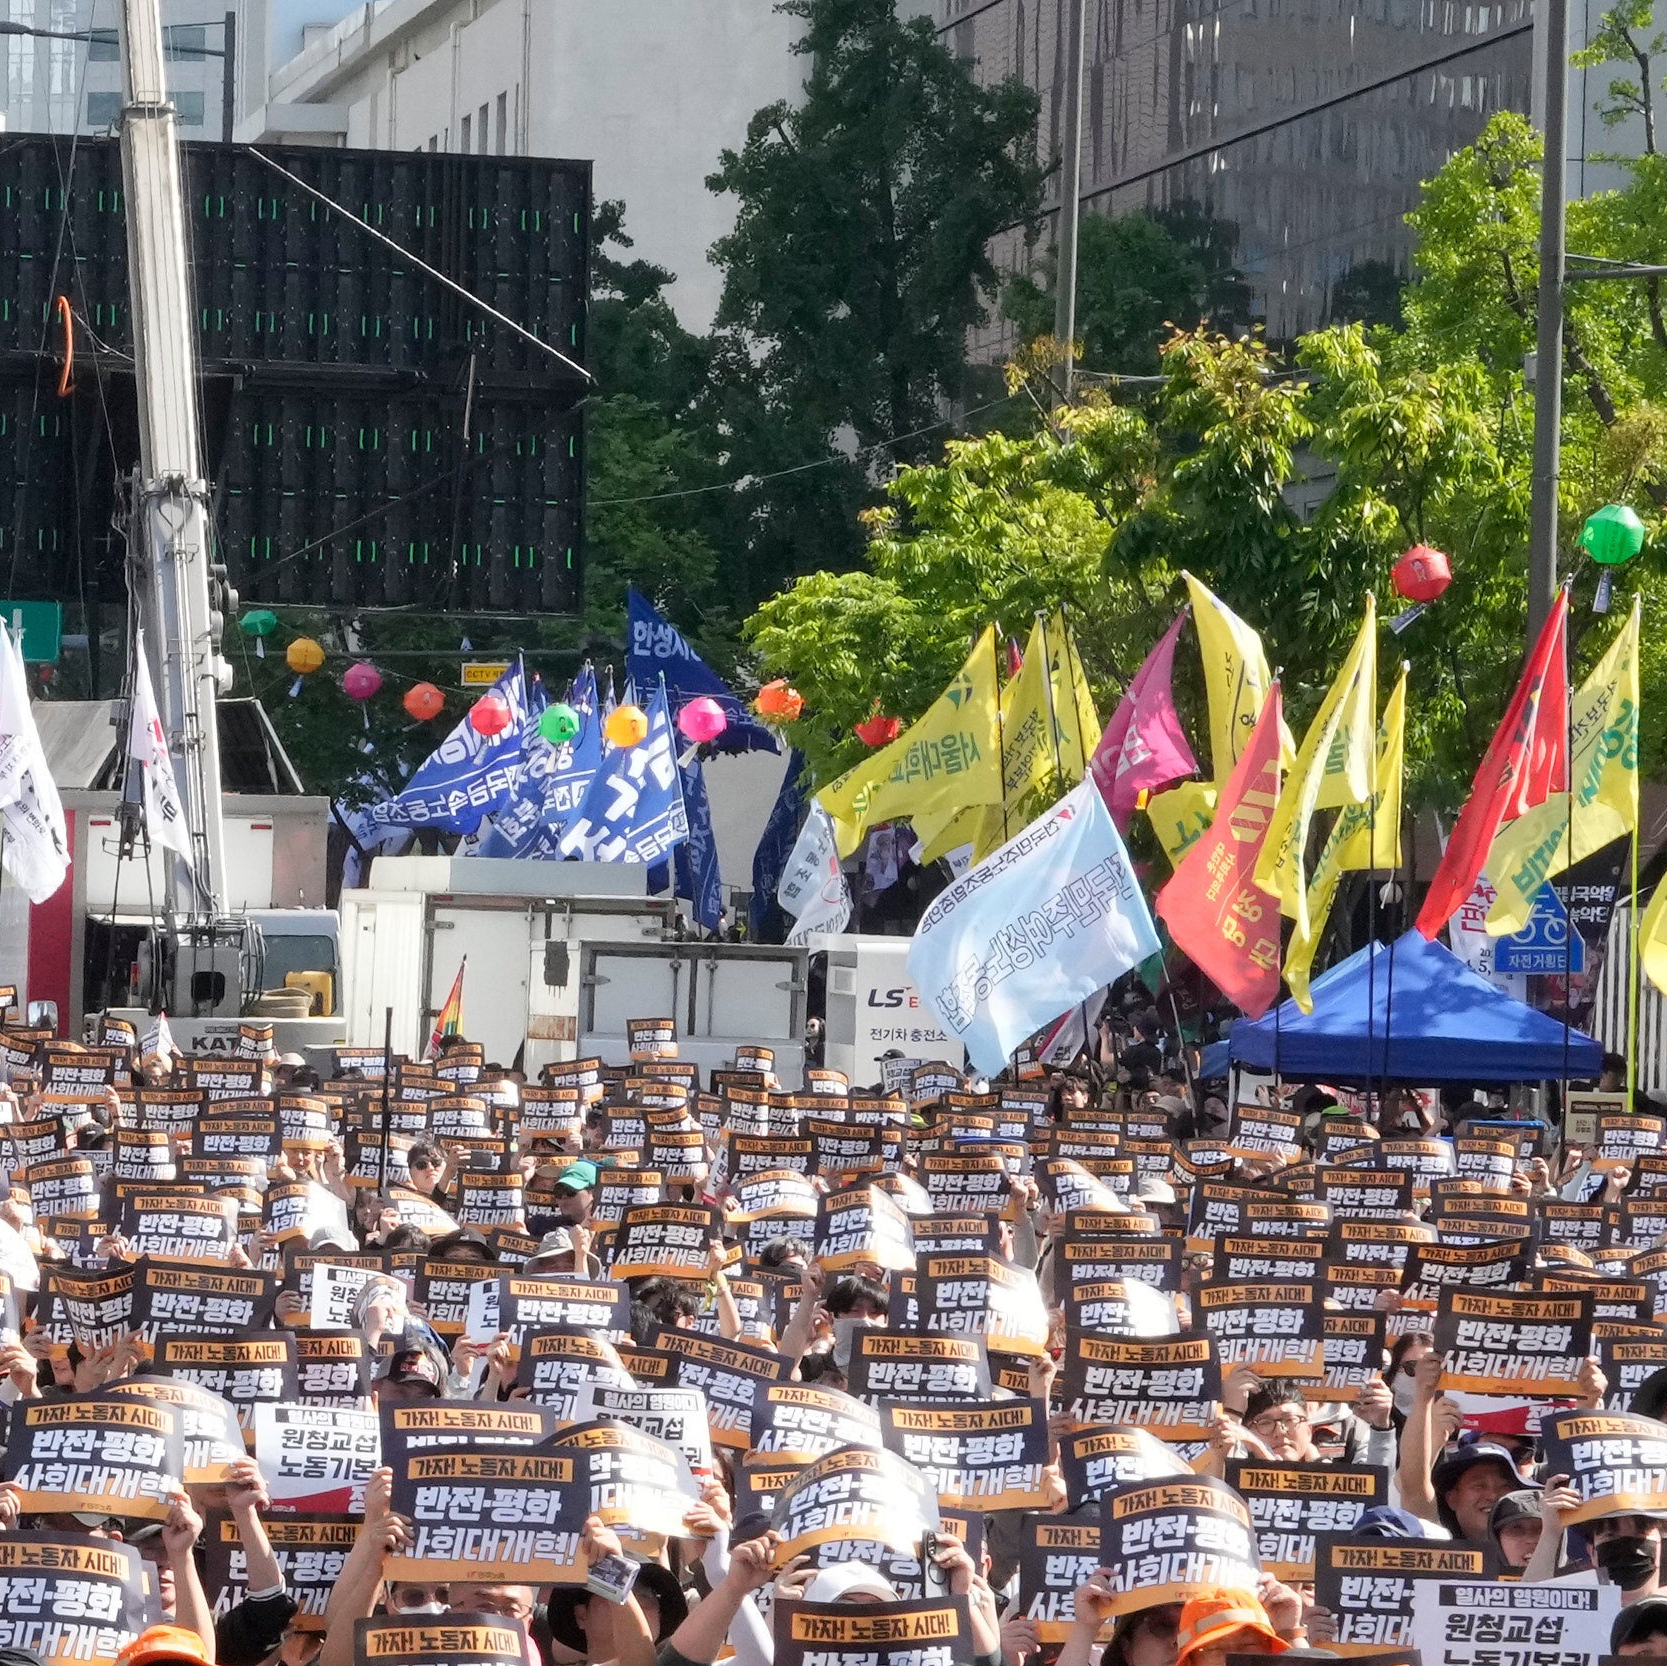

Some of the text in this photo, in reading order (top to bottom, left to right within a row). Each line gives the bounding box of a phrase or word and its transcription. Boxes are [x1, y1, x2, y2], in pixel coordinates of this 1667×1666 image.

[868, 989, 904, 1007] LS
[870, 1029, 947, 1042] 전기차 충전소
